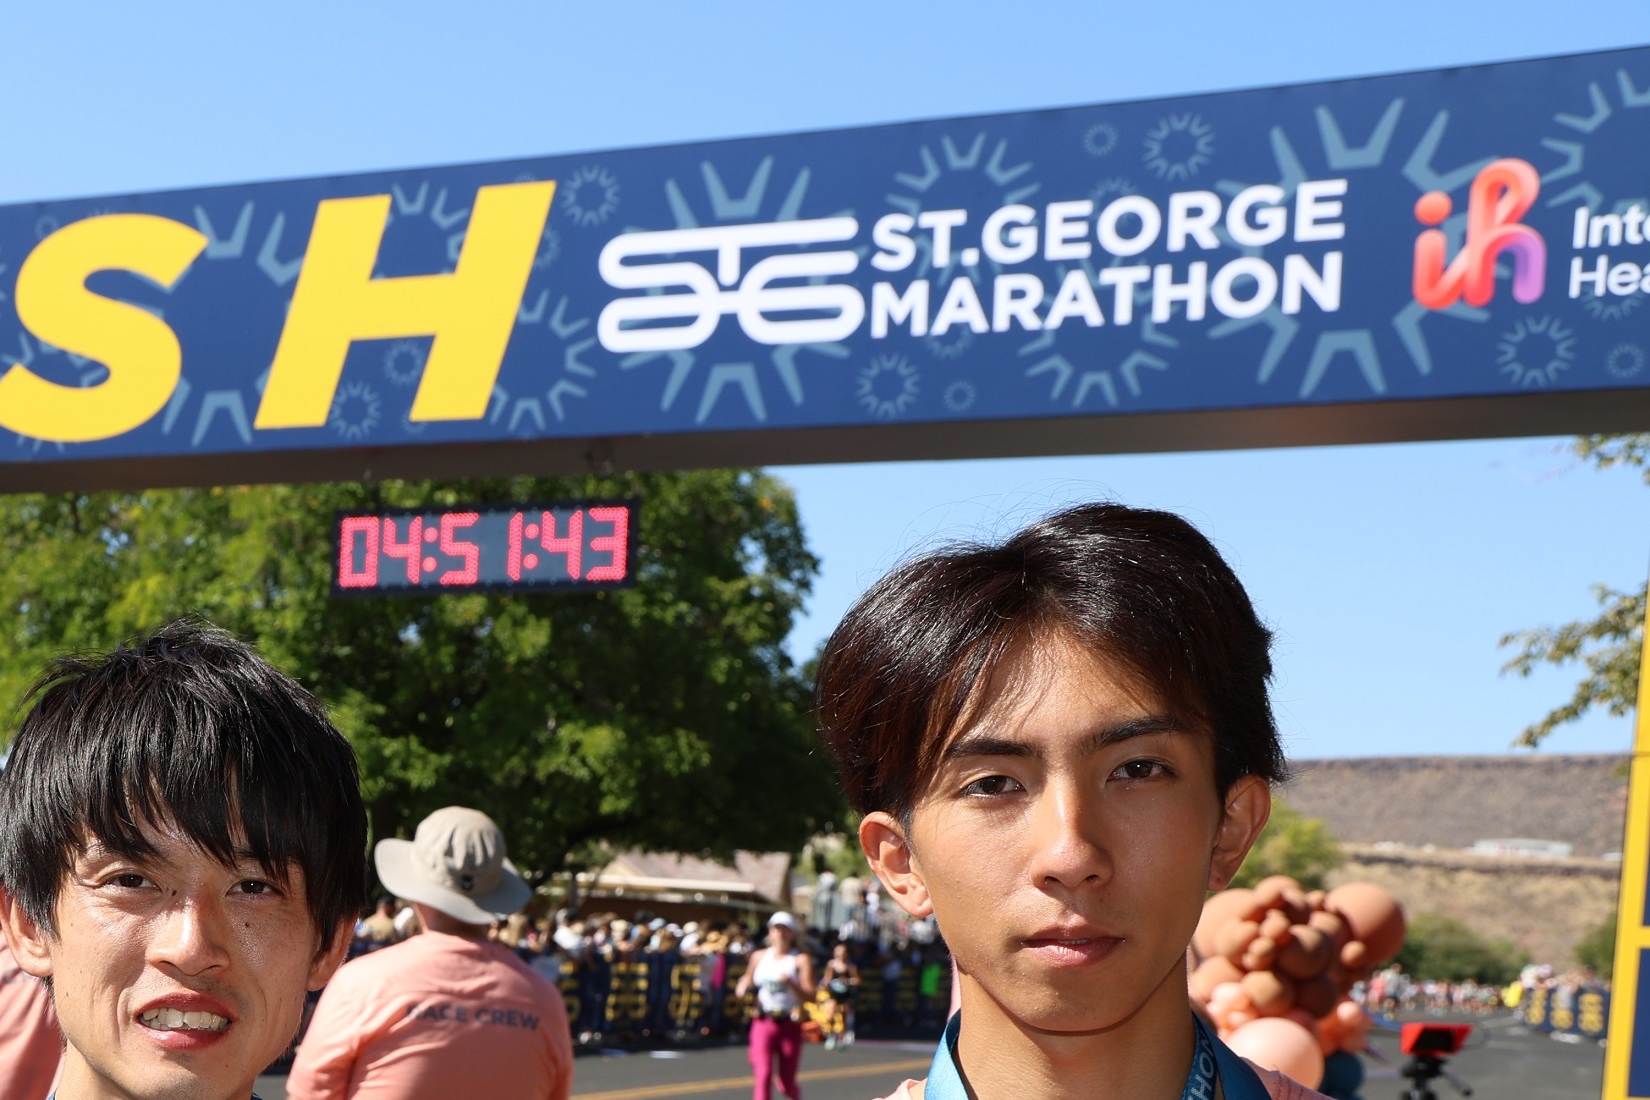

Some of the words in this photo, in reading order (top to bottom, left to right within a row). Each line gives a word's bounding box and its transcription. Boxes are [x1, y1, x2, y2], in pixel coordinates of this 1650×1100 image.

[871, 179, 1347, 272] ST.GEORGE
[1572, 204, 1650, 249] Int
[871, 252, 1343, 339] MARATHON
[475, 1008, 540, 1031] CREW
